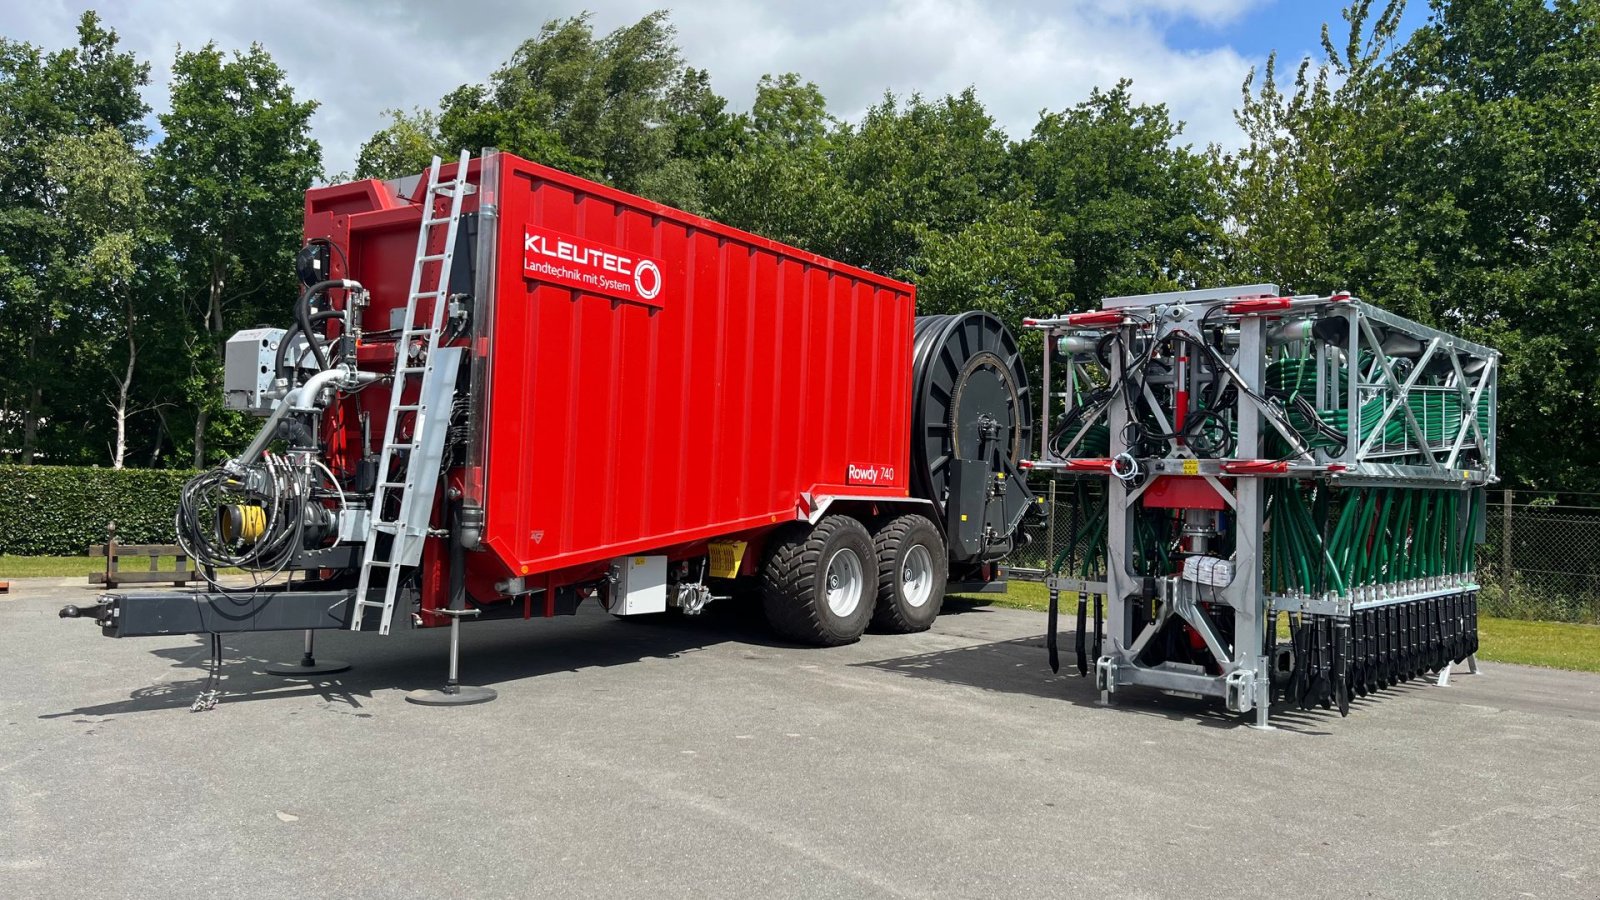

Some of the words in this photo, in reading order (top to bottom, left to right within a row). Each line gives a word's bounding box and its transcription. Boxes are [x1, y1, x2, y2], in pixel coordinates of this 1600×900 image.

[525, 233, 631, 275] KLEUTEC
[524, 257, 580, 281] Landtechnik
[583, 273, 597, 285] mit
[600, 275, 630, 292] System
[849, 464, 878, 484] Rowdy
[880, 467, 894, 480] 740
